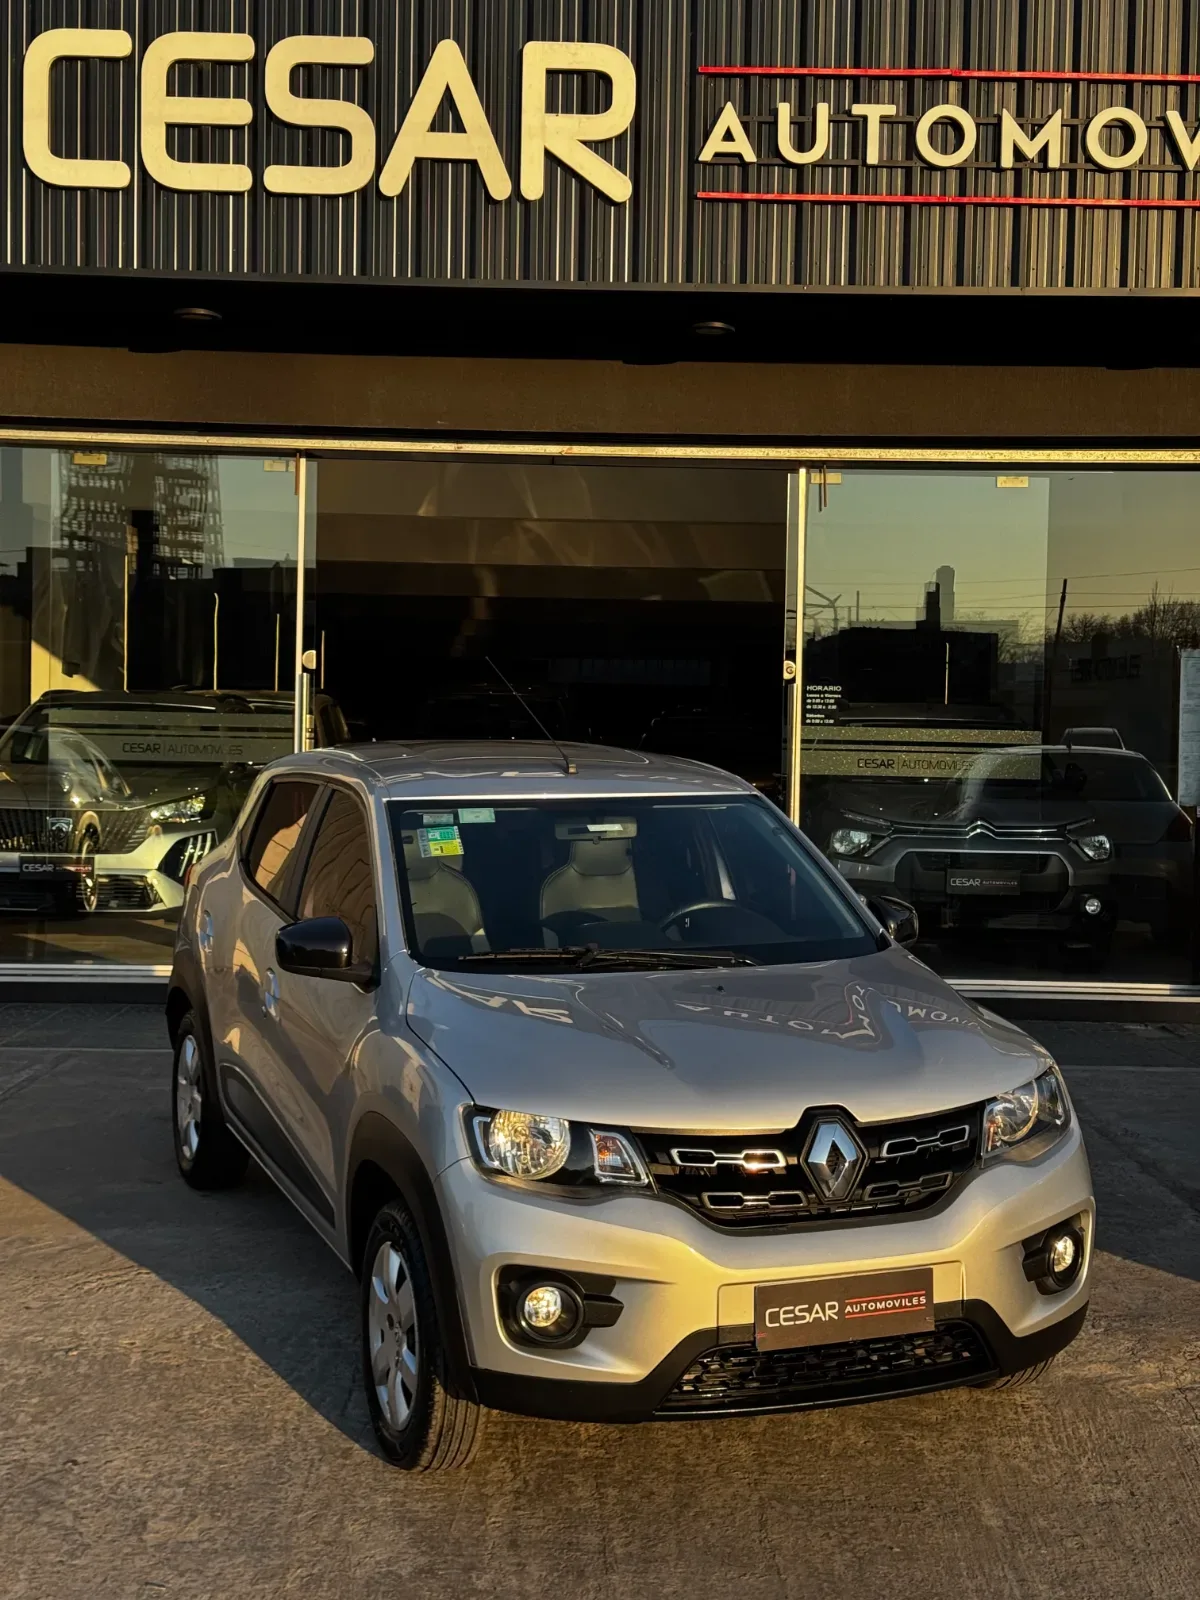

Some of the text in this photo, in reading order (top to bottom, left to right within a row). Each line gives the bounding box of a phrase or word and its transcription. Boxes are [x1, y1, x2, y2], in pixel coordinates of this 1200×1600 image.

[22, 27, 1200, 203] CESAR AUTOMOV
[122, 742, 161, 753] CESAR
[857, 758, 894, 769] CESAR
[22, 863, 54, 872] CESAR
[950, 878, 981, 887] CESAR
[765, 1296, 927, 1327] CESAR AUTOMOVILES
